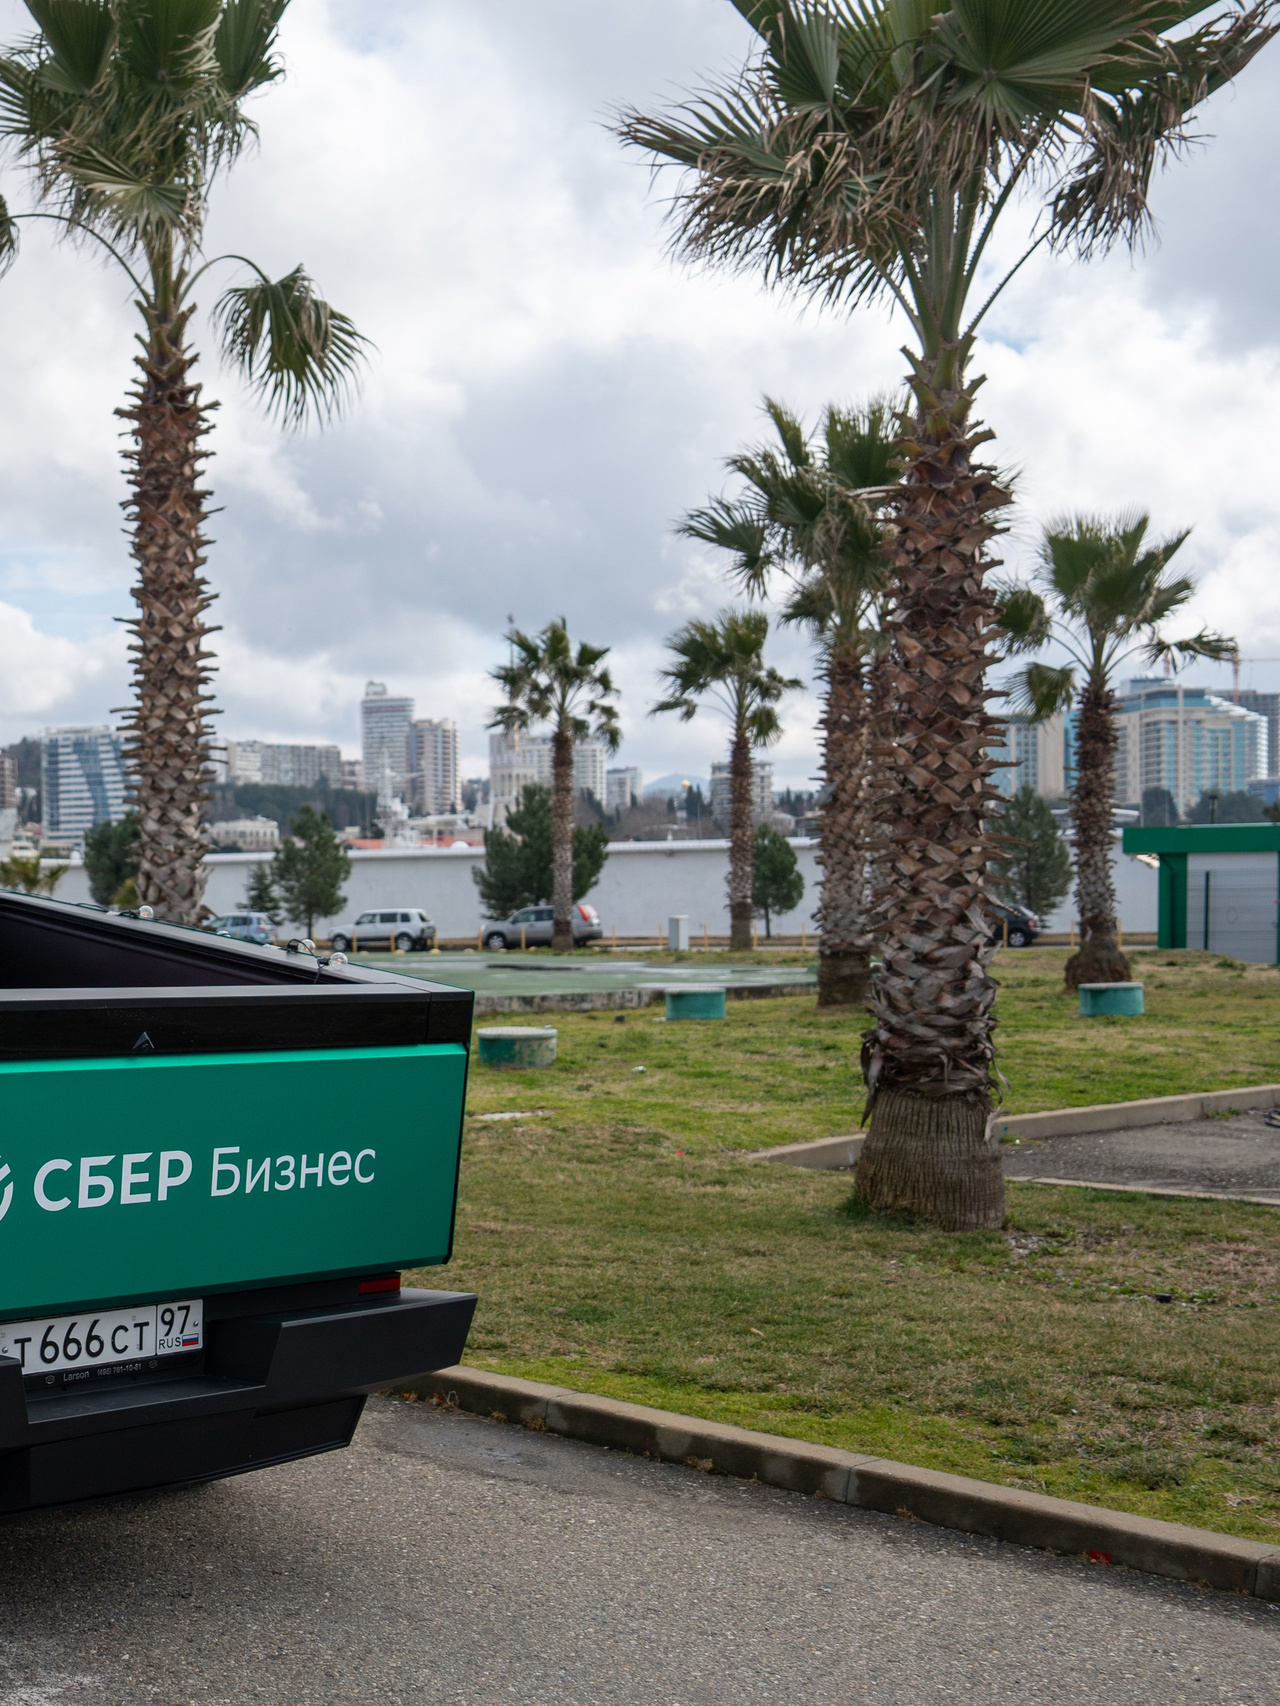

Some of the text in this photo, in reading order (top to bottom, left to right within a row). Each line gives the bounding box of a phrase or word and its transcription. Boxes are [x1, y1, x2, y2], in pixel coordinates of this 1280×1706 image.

[33, 1146, 376, 1212] СБЕР Бизнес
[160, 1305, 191, 1337] 97
[158, 1336, 181, 1350] RUS
[63, 1370, 90, 1382] Larson
